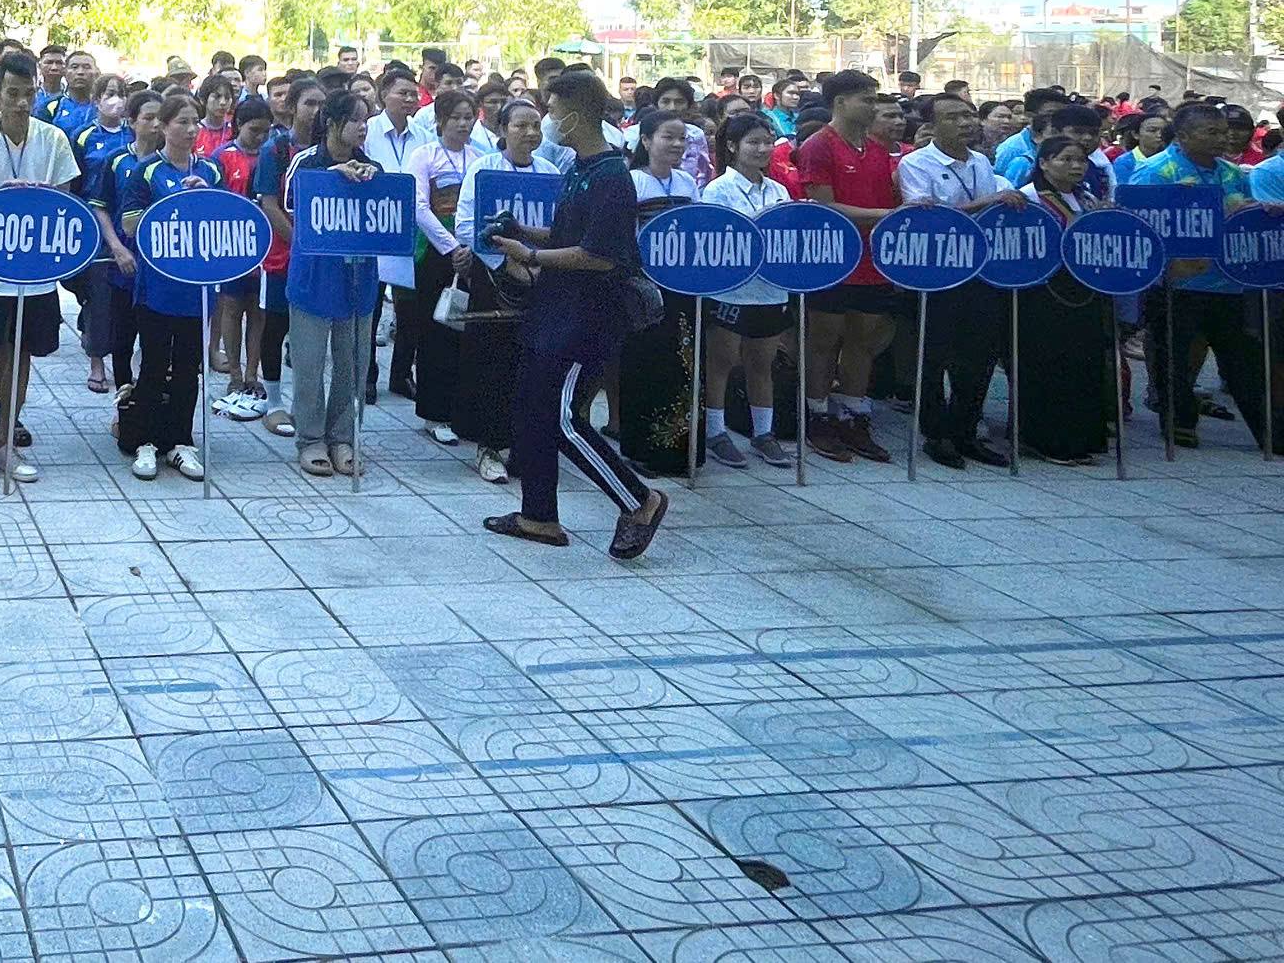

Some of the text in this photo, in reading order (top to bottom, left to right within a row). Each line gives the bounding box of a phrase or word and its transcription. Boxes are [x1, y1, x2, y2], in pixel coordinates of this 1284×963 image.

[39, 208, 83, 262] LẶC
[310, 196, 402, 235] QUAN SƠN
[1176, 202, 1213, 238] LIÊN
[198, 219, 258, 262] QUANG
[649, 219, 752, 267] HỒI XUÂN
[801, 222, 844, 264] XUÂN
[880, 217, 975, 268] CẨM TÂN
[1025, 219, 1046, 259] TÚ
[1073, 230, 1152, 277] THẠCH LẬP
[1223, 226, 1259, 269] LUẬN
